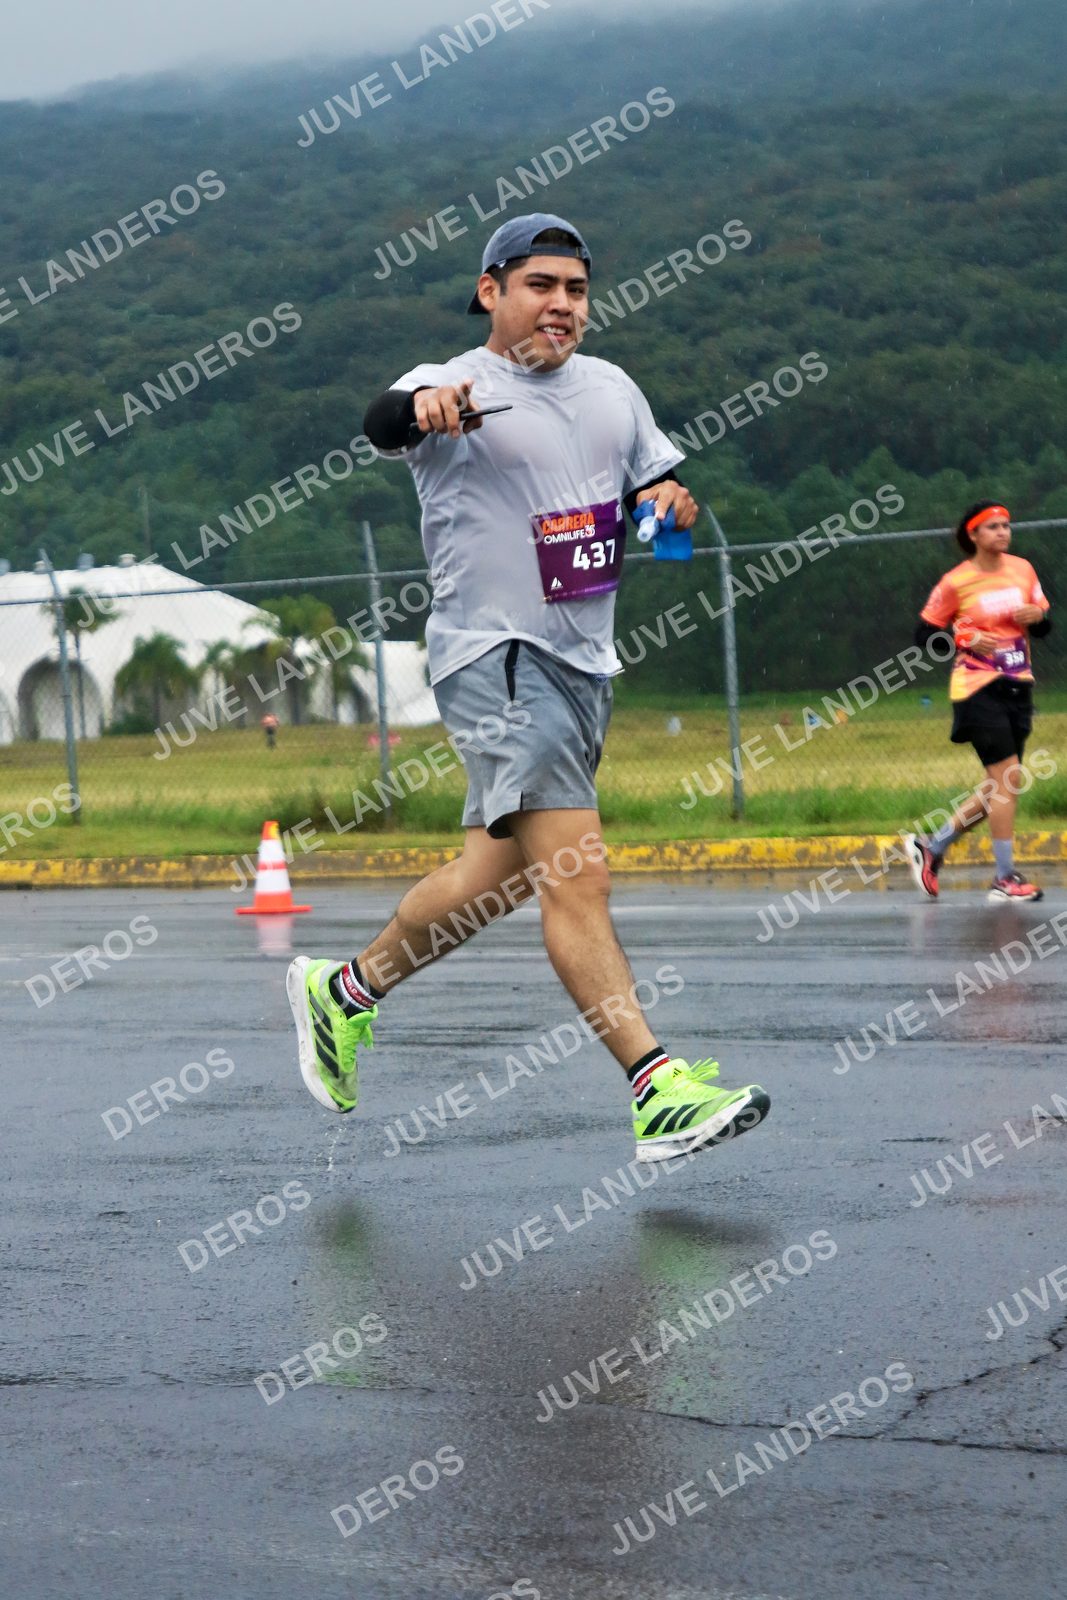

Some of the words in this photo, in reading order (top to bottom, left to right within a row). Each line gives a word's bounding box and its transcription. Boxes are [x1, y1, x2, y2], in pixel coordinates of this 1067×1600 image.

[543, 512, 595, 534] CARRERA
[544, 529, 586, 544] OMNILIFE
[572, 538, 616, 570] 437
